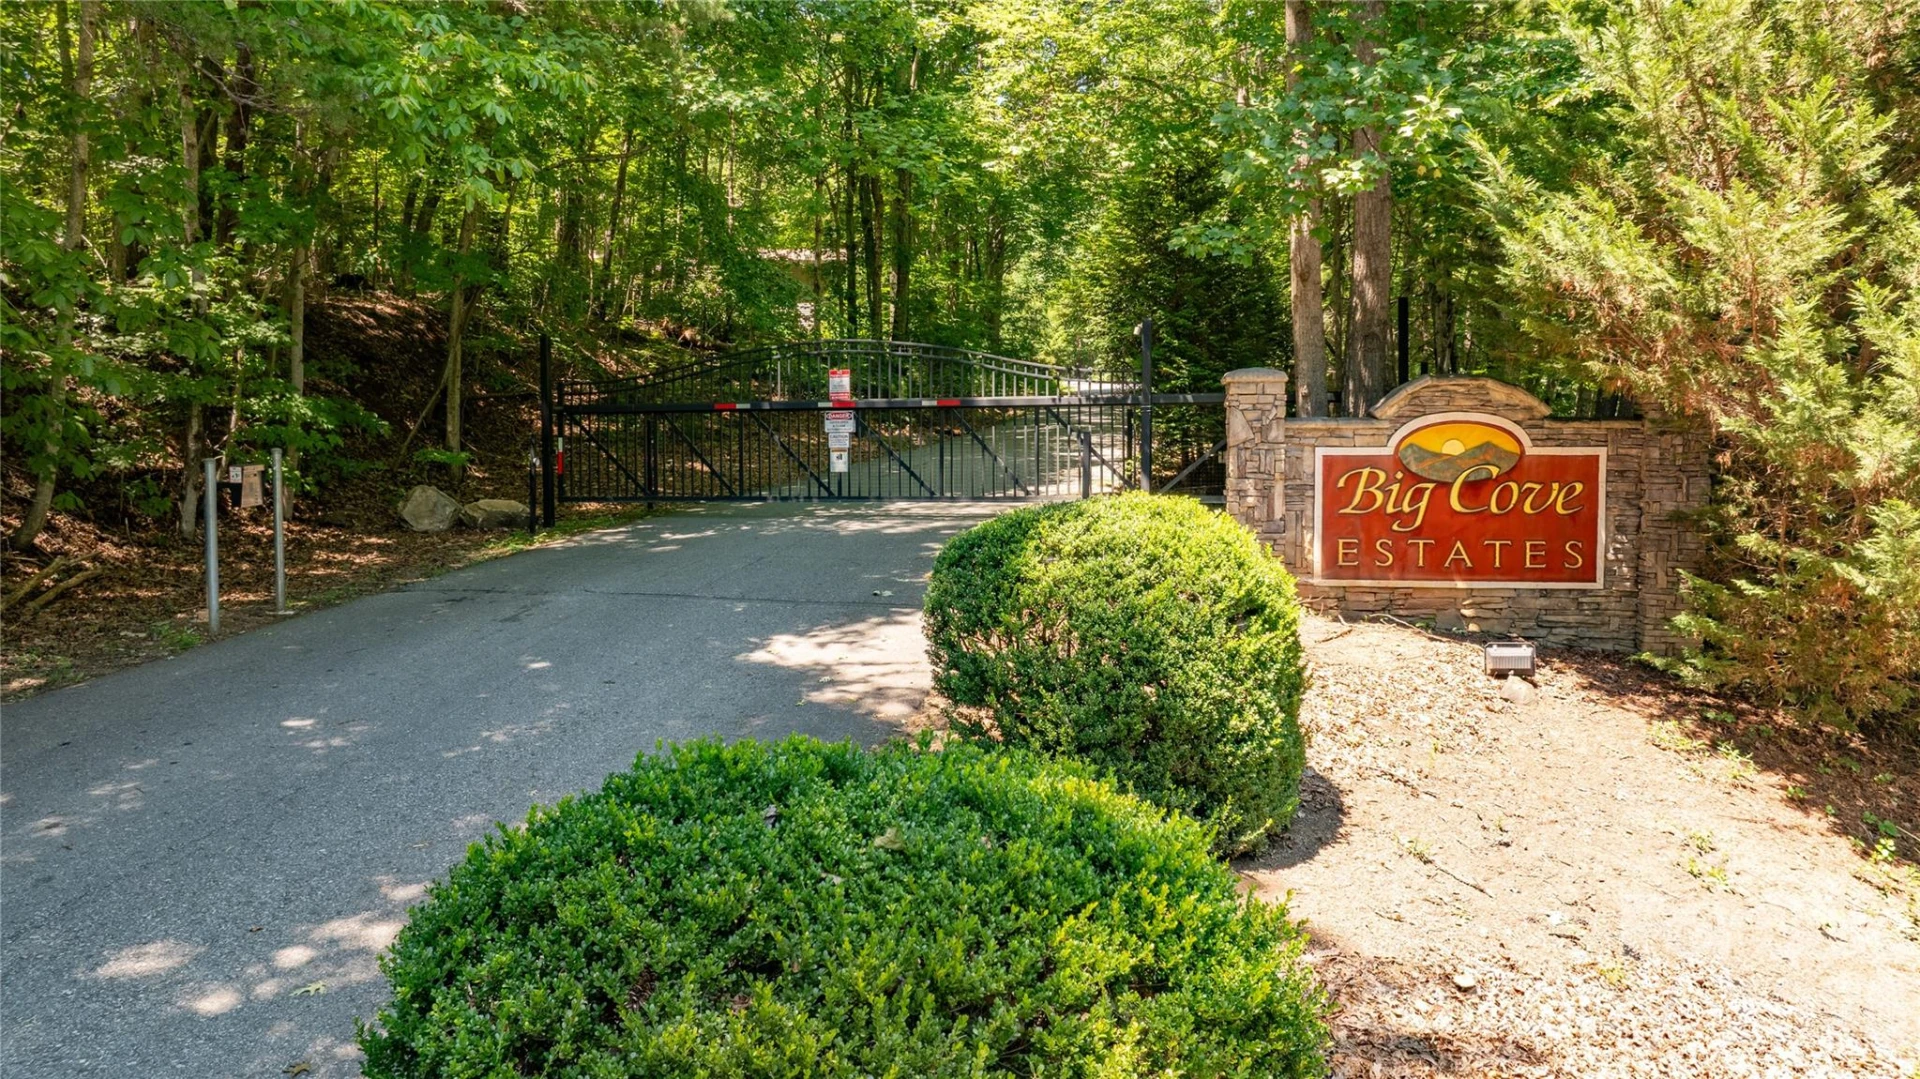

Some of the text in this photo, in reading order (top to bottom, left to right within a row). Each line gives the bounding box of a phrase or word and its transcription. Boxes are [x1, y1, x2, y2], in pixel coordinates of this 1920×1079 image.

[1337, 464, 1584, 531] Big Cove
[1337, 538, 1583, 569] ESTATES
